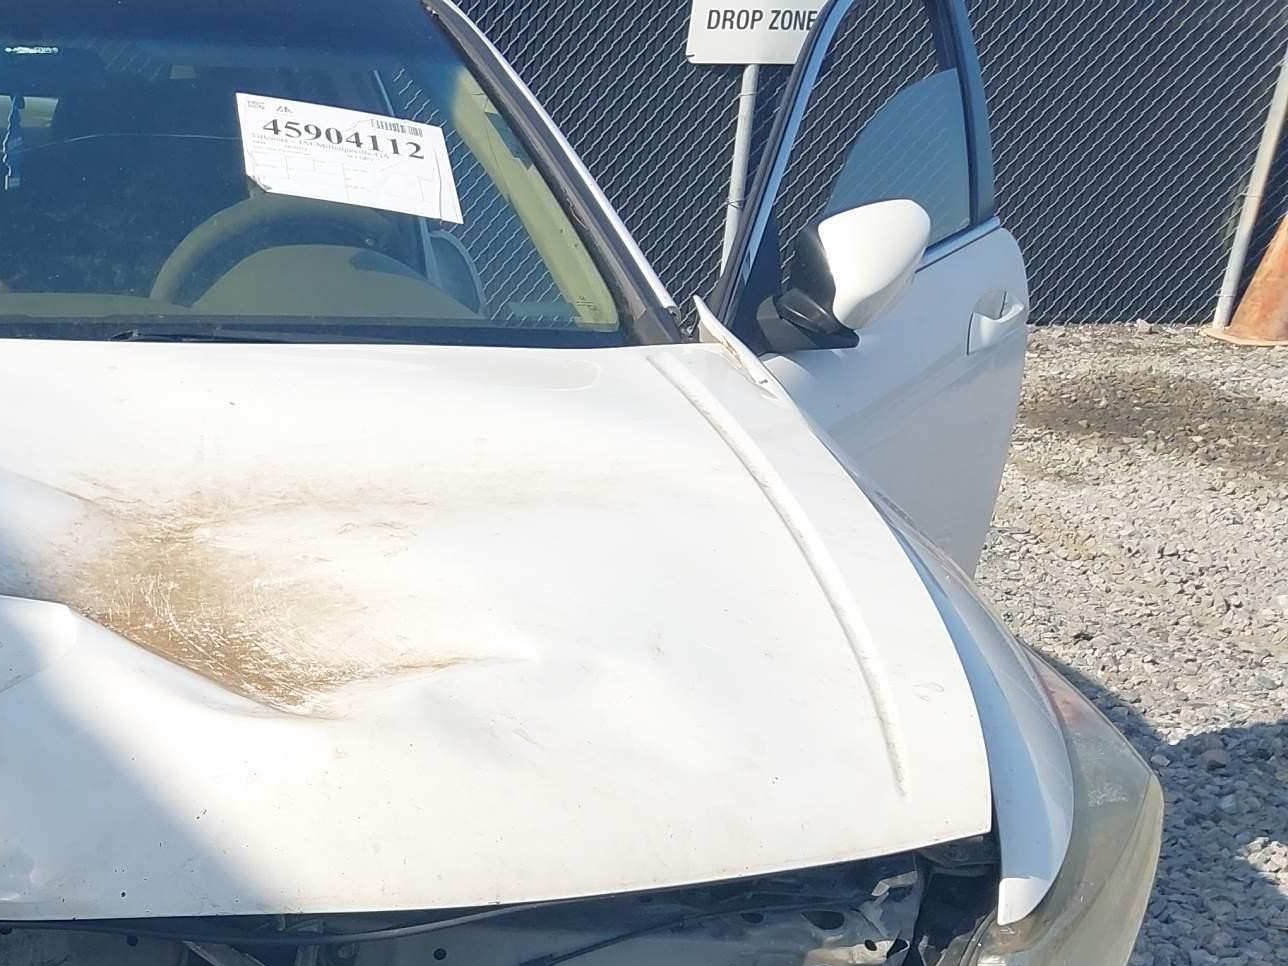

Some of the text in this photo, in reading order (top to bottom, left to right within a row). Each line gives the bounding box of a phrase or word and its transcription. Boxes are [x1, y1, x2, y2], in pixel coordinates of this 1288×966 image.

[706, 9, 817, 31] DROP ZONE
[262, 118, 425, 159] 45904112
